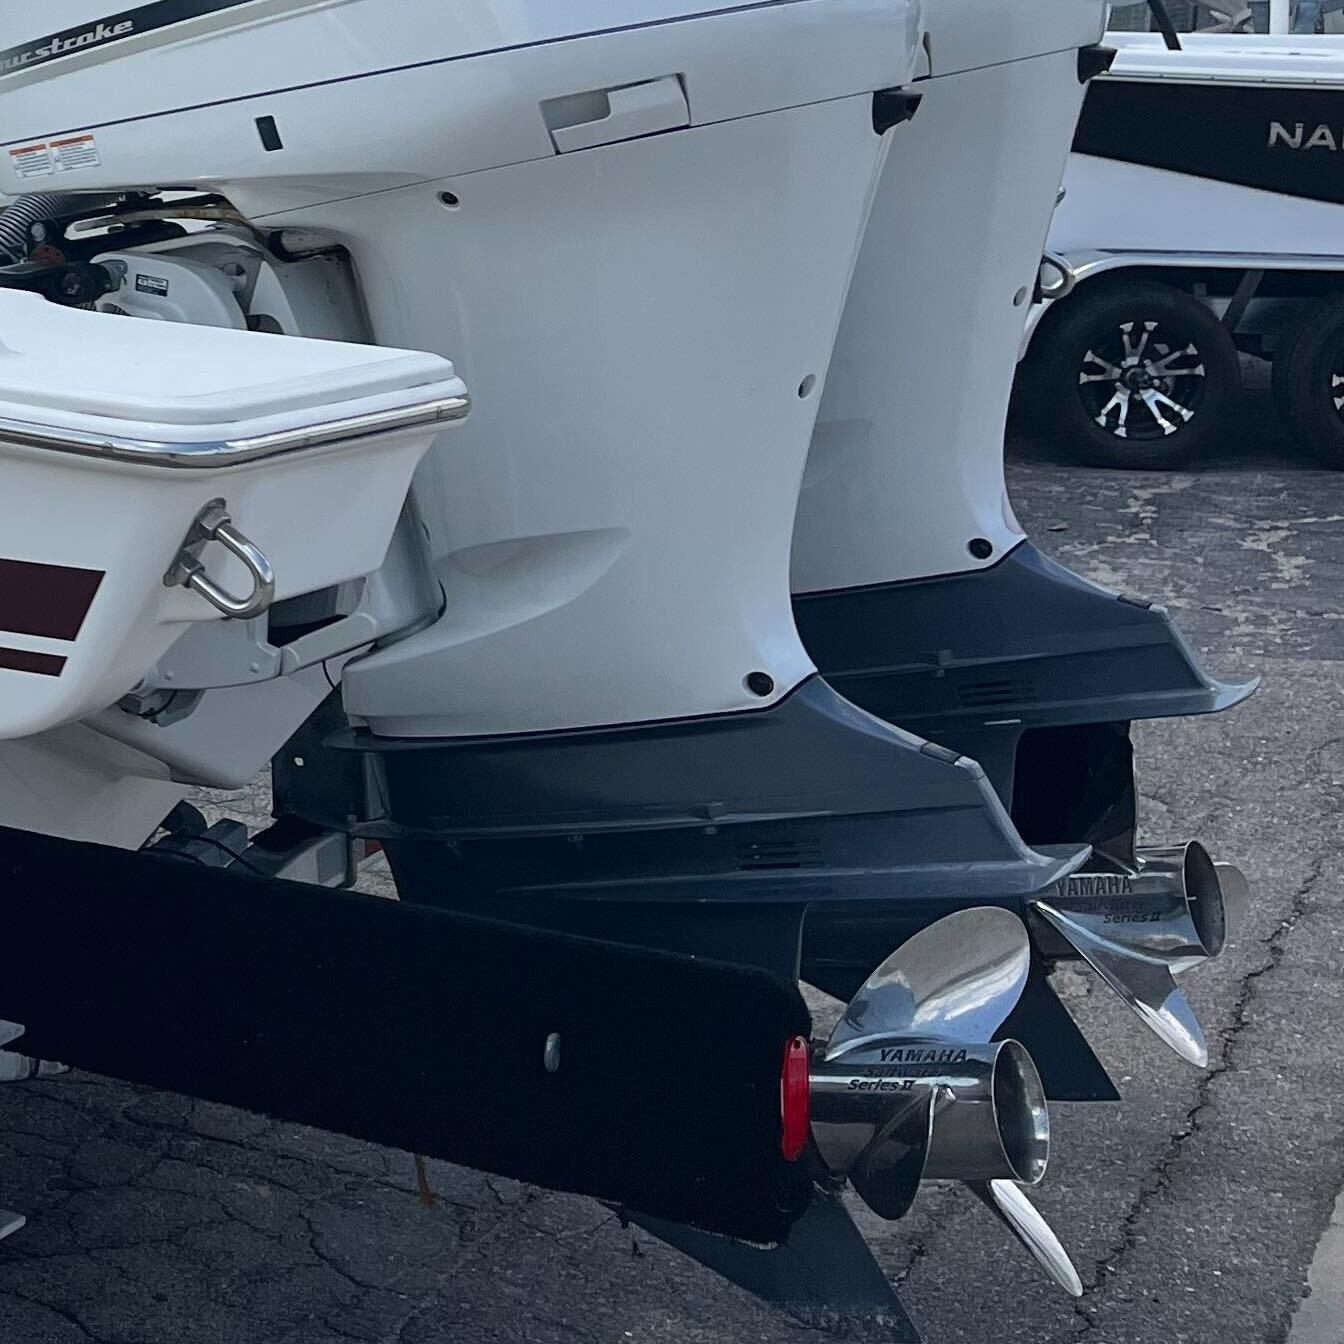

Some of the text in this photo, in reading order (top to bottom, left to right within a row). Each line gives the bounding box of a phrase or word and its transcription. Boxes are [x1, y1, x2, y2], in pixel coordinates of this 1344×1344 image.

[1267, 122, 1344, 151] NA
[1055, 875, 1133, 897] YAMAHA
[1103, 912, 1147, 924] Series
[879, 1048, 968, 1063] YAMAHA
[847, 1078, 899, 1092] Series
